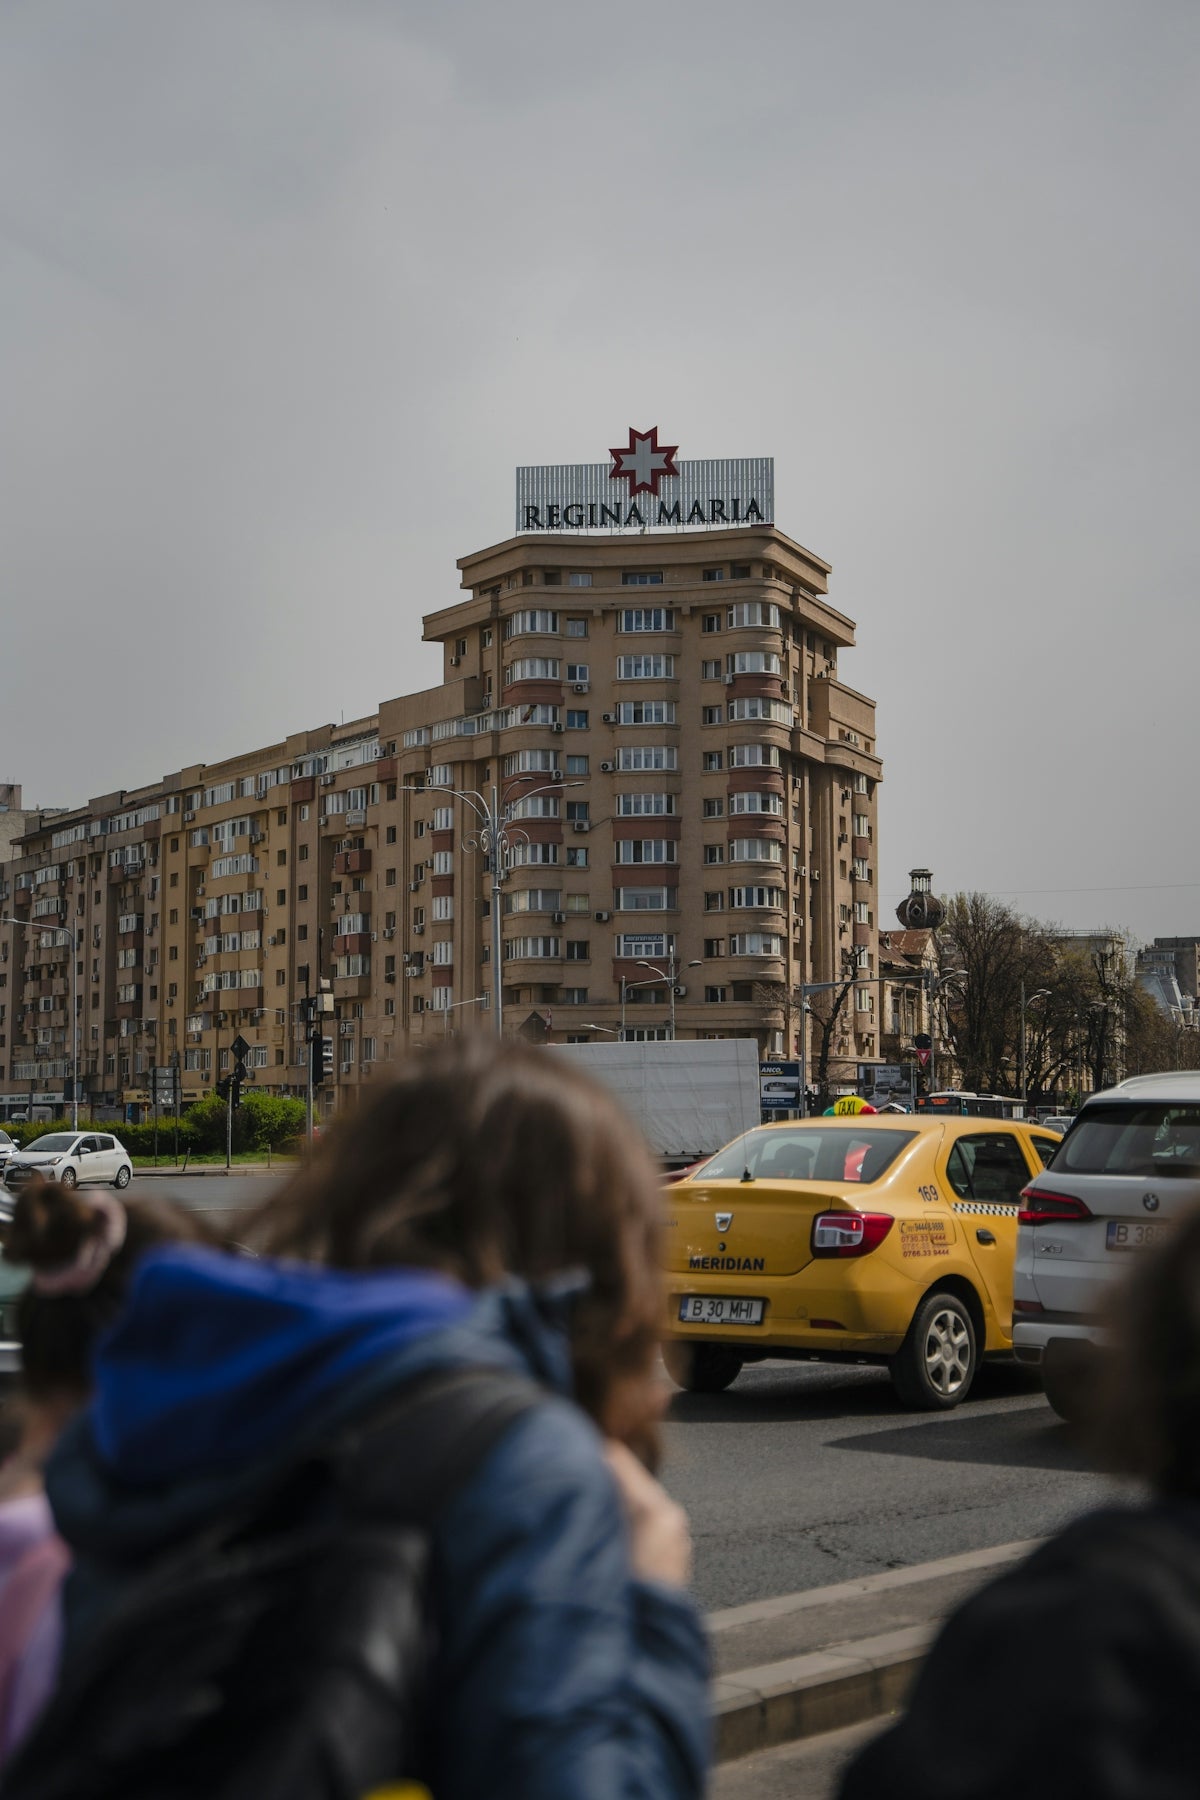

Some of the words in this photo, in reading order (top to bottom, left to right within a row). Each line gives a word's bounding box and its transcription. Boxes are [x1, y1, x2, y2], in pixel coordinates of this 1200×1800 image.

[523, 501, 646, 528] REGINA
[656, 497, 765, 524] MARIA
[838, 1102, 855, 1115] TAXI
[918, 1185, 938, 1201] 169
[1116, 1224, 1129, 1243] B
[689, 1257, 765, 1271] MERIDIAN
[692, 1300, 703, 1317] B
[706, 1301, 724, 1317] 30
[729, 1301, 754, 1319] MHI
